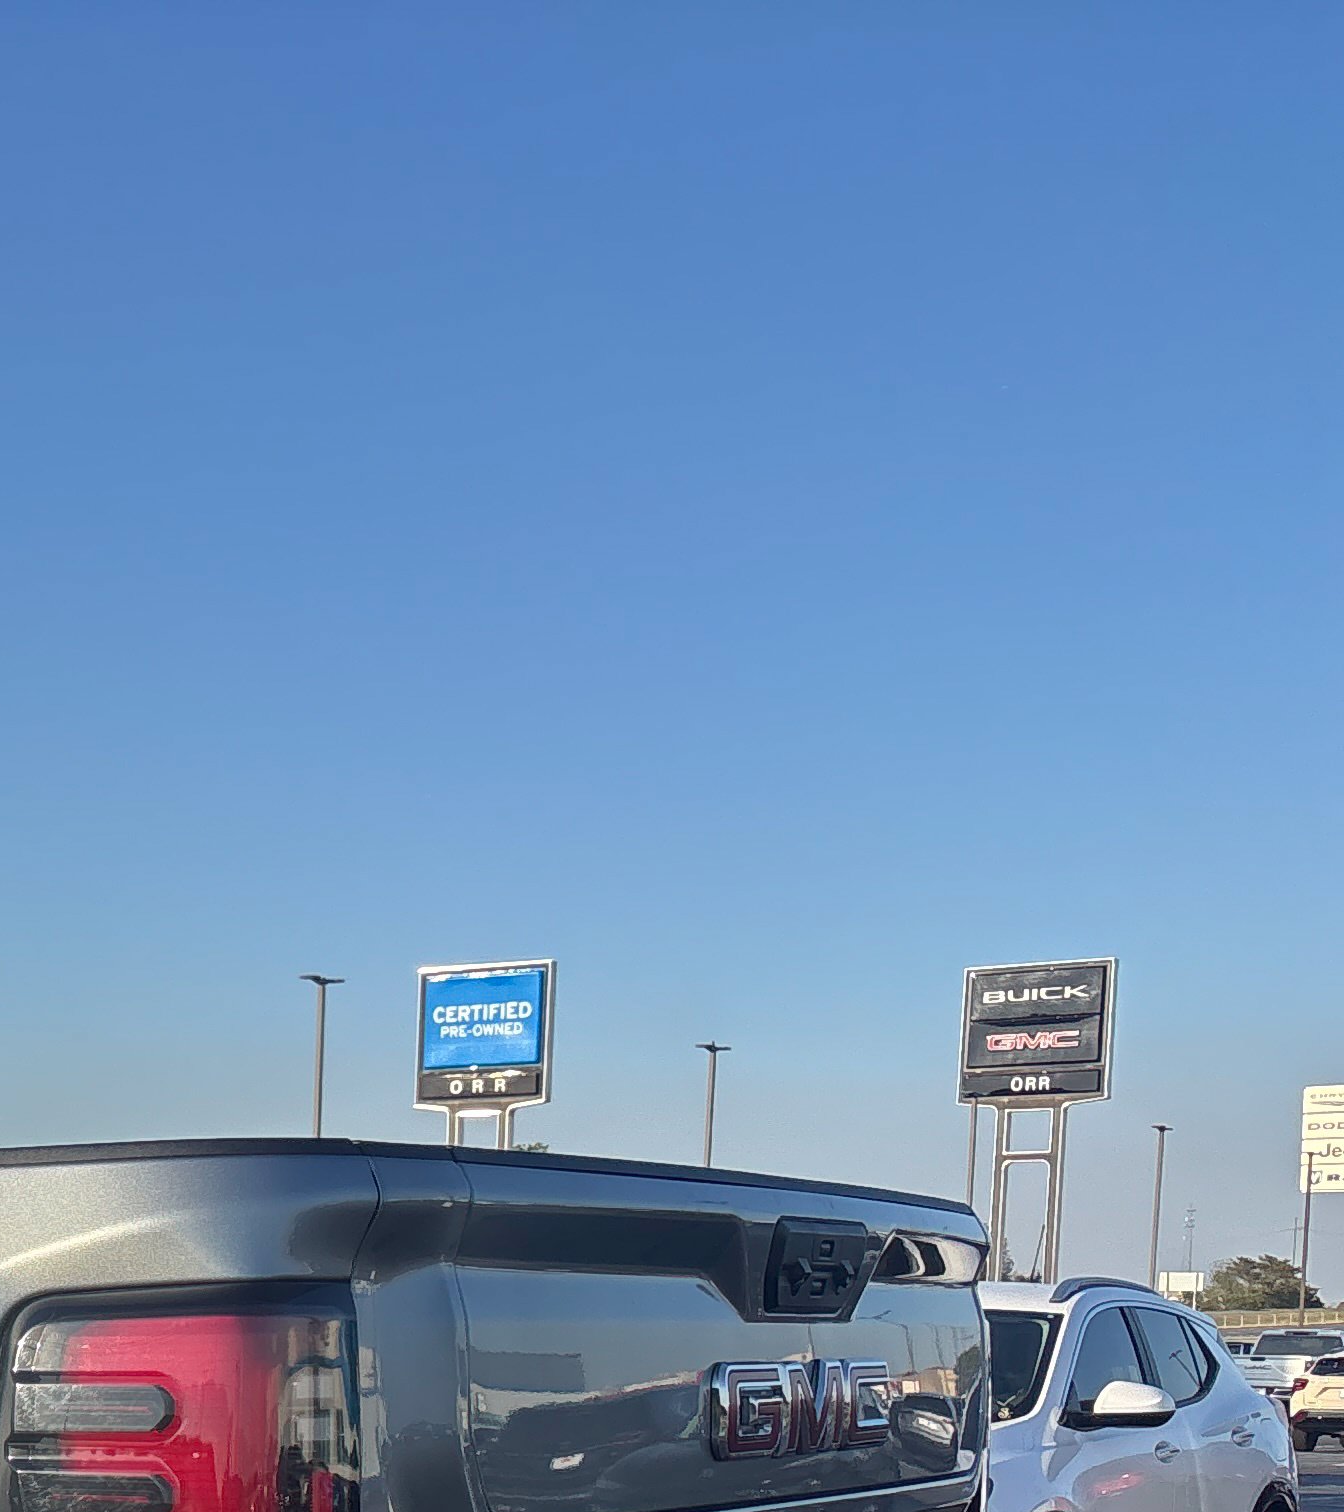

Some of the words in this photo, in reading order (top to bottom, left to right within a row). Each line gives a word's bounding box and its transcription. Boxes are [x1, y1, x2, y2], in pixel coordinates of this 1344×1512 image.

[982, 984, 1090, 1004] BUICK
[432, 1001, 533, 1024] CERTIFIED
[440, 1022, 523, 1039] PRE-OWNED
[986, 1029, 1080, 1052] GMC
[449, 1078, 507, 1095] ORR
[1010, 1075, 1051, 1092] ORR
[704, 1358, 890, 1461] GMC
